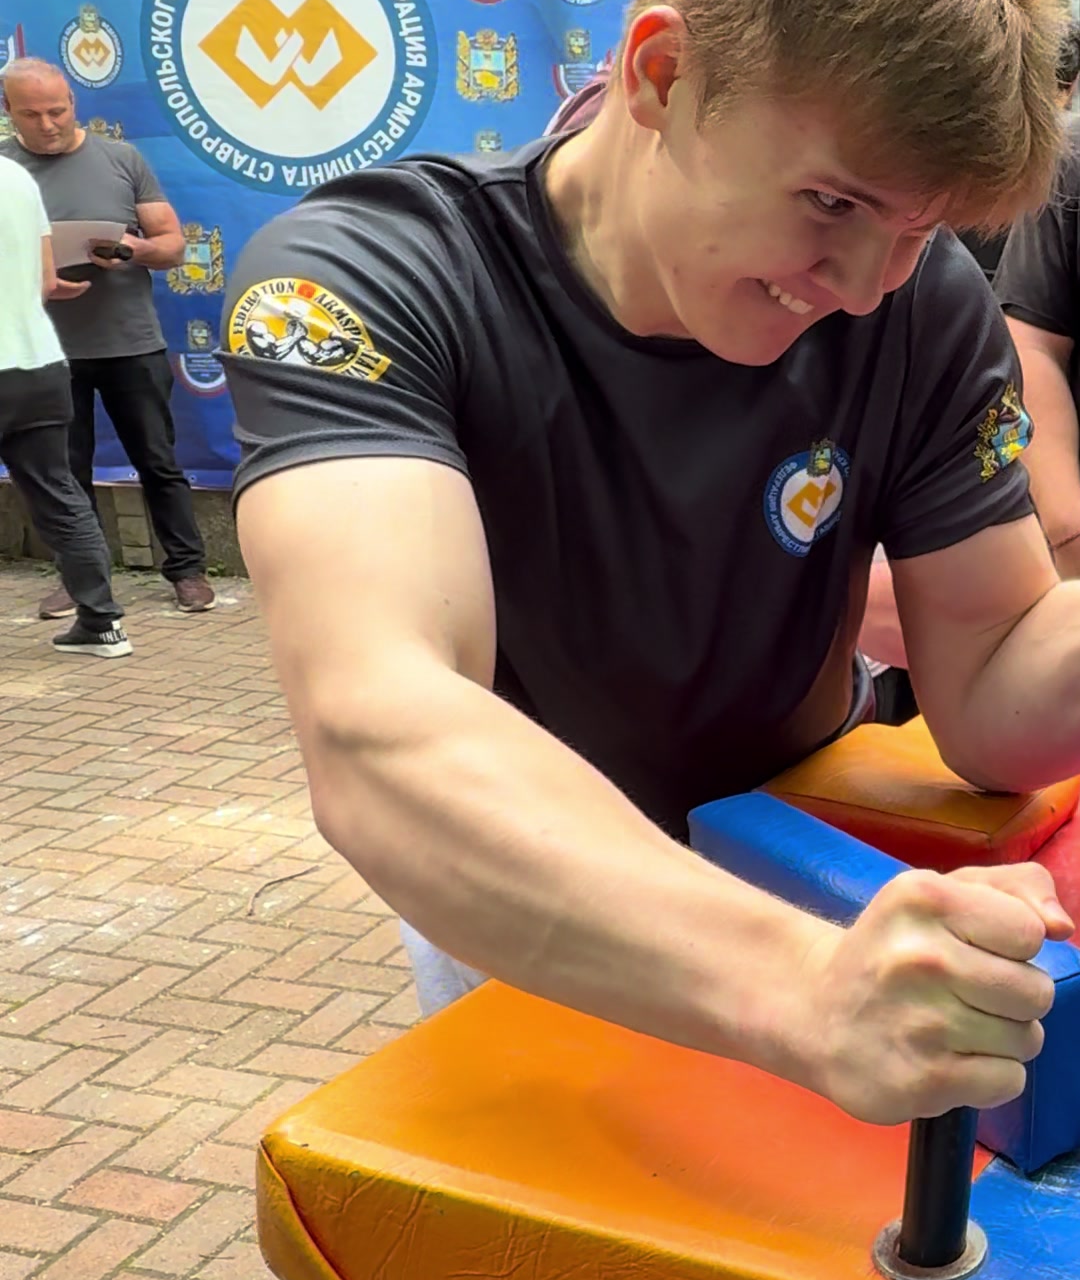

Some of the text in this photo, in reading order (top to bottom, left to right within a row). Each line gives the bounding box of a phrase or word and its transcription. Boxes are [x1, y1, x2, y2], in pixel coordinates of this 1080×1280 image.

[281, 73, 425, 187] АРМРЕСТЛИНГА
[232, 281, 366, 346] FEDERATION ARMSP
